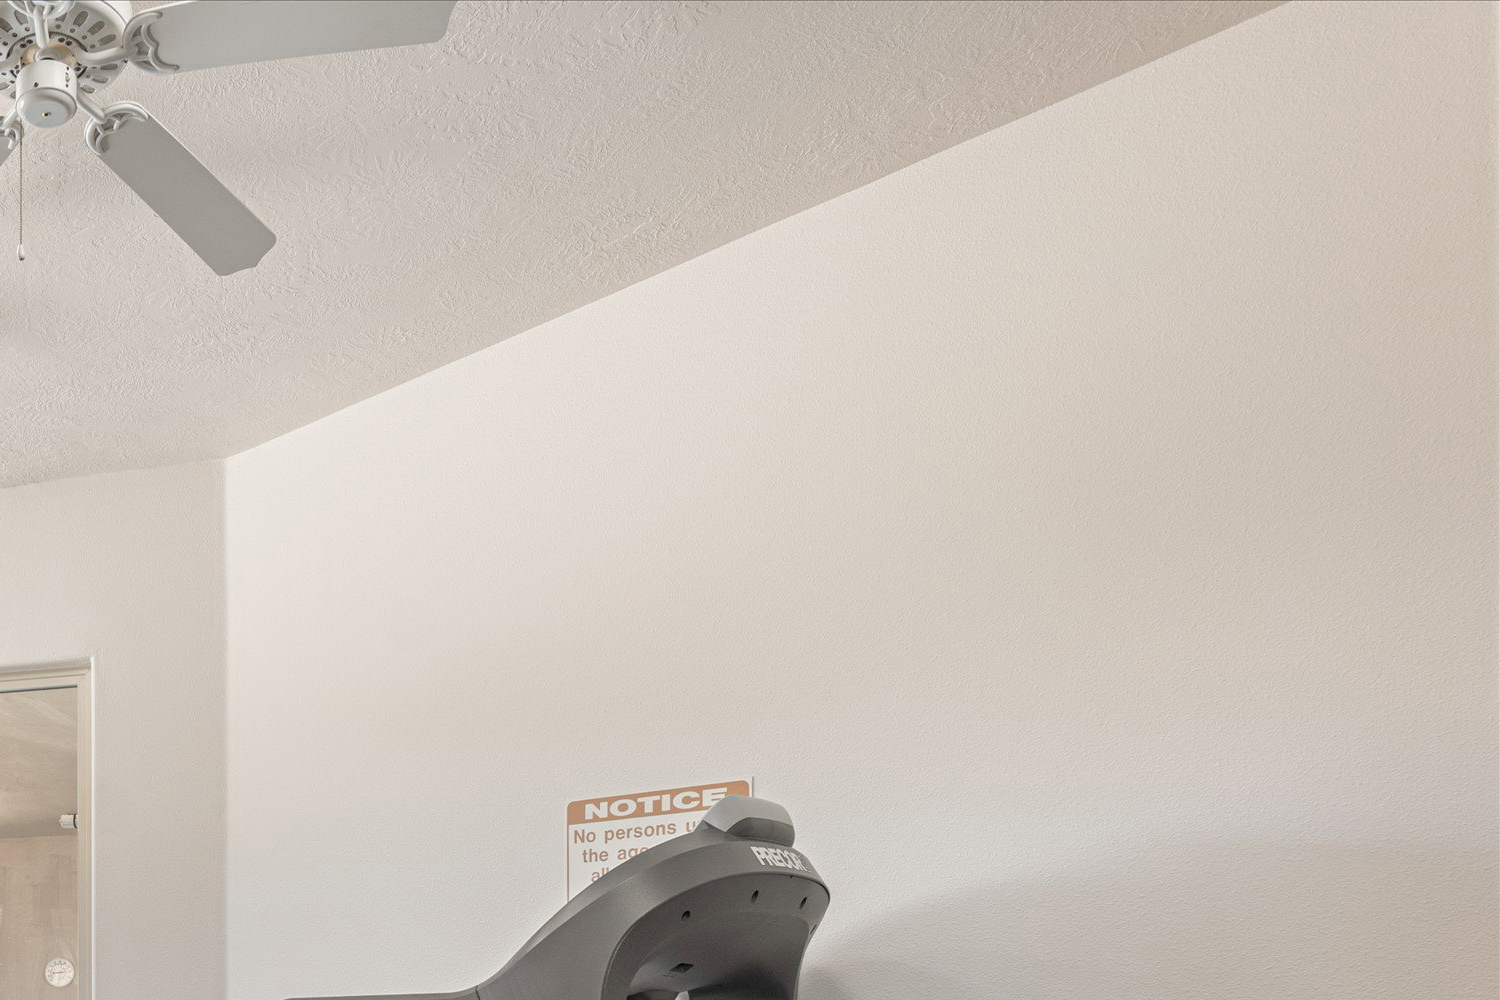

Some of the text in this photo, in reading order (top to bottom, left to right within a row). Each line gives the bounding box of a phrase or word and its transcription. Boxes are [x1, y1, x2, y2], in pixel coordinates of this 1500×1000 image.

[584, 787, 728, 820] NOTICE
[574, 829, 597, 844] No
[604, 823, 677, 844] persons
[582, 848, 609, 863] the
[750, 846, 807, 872] PRECOR
